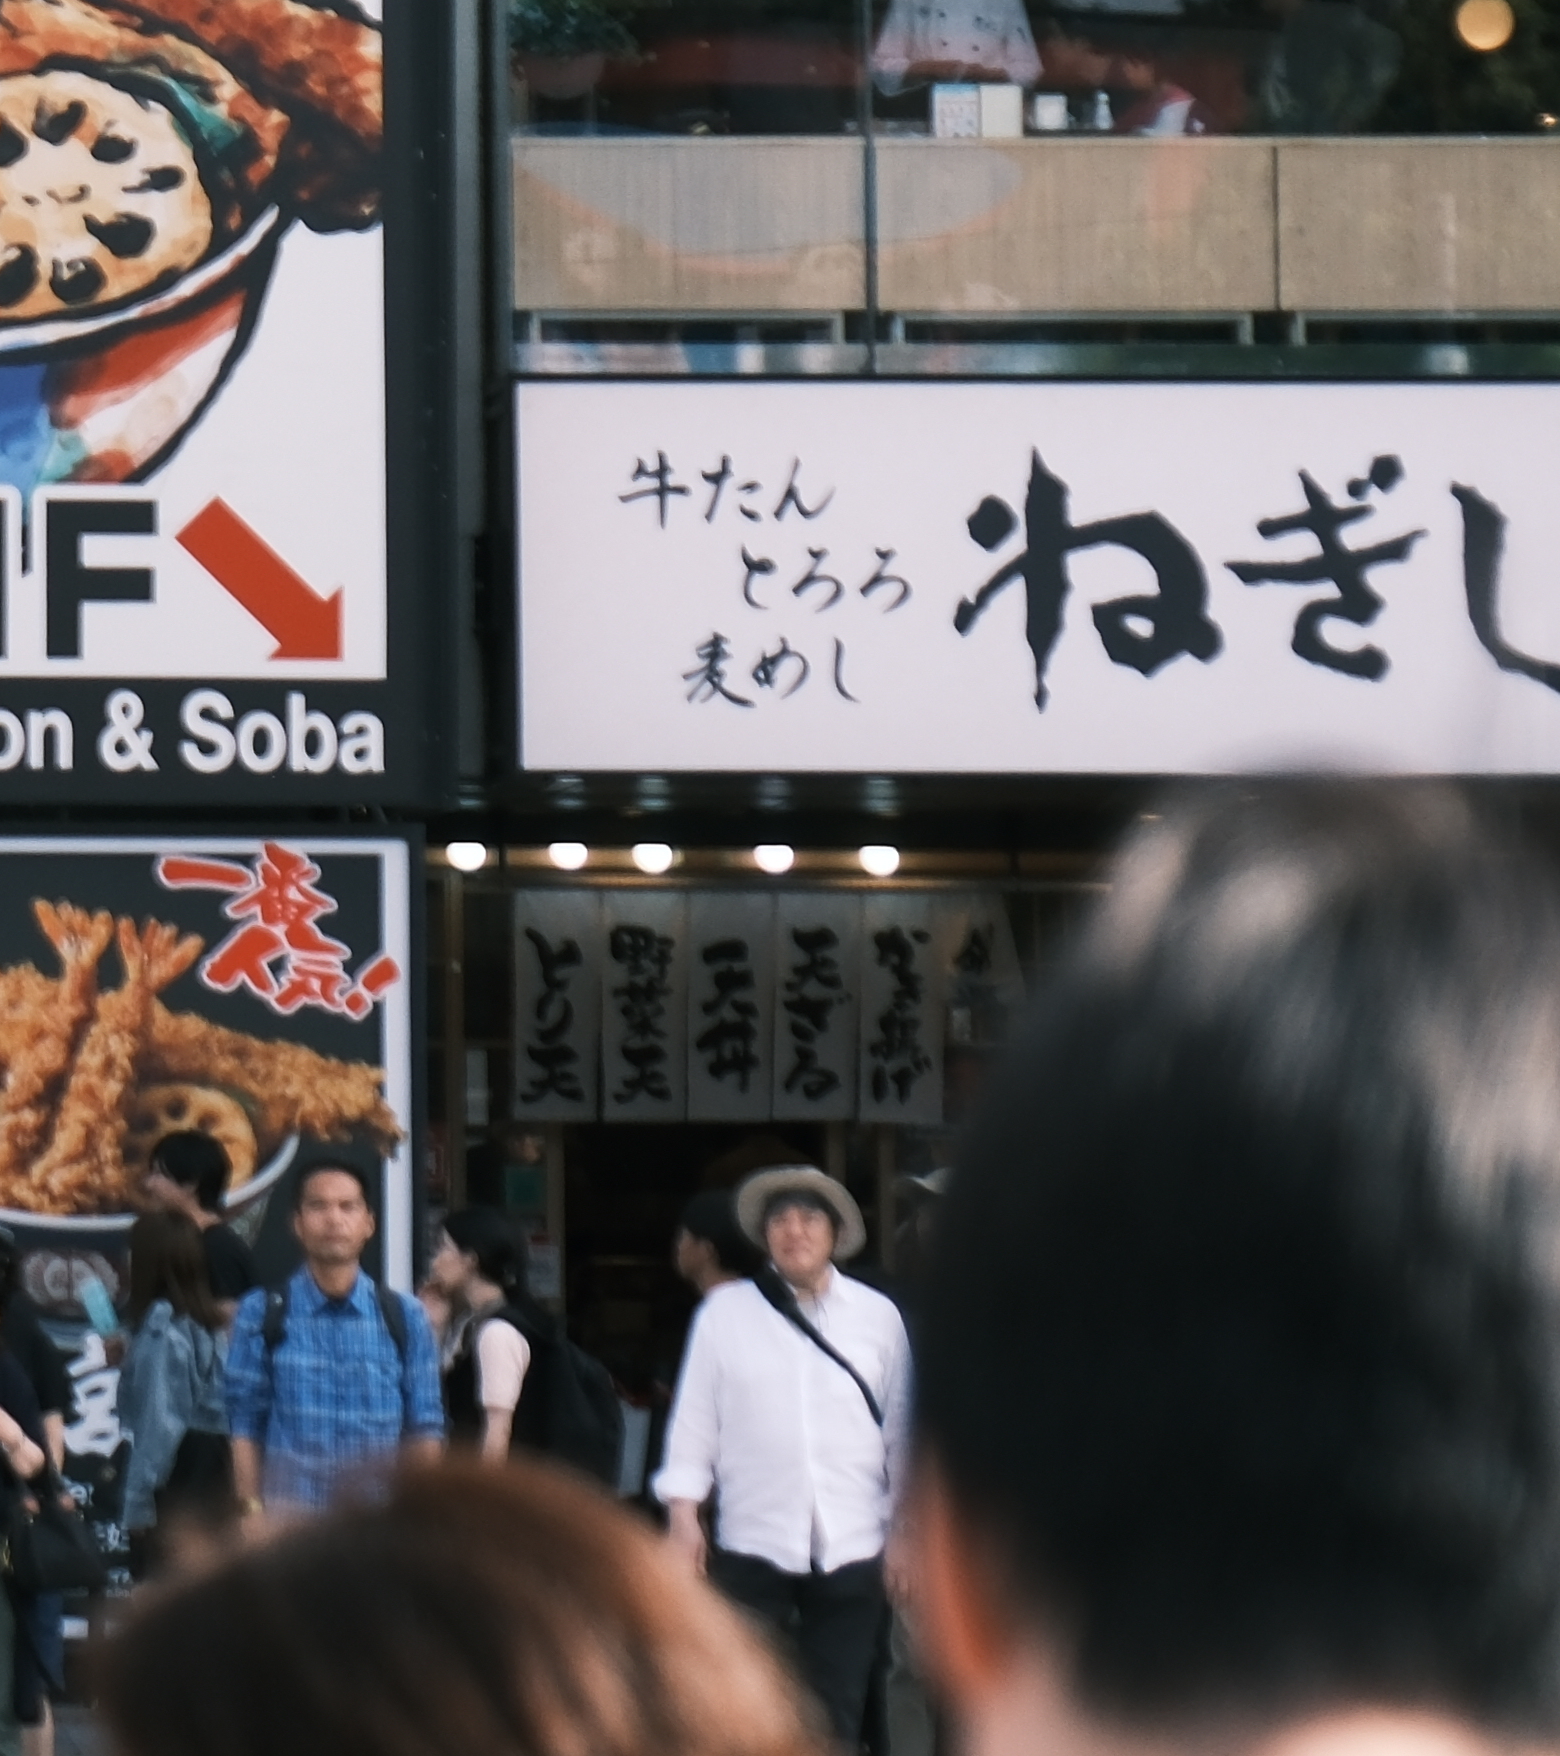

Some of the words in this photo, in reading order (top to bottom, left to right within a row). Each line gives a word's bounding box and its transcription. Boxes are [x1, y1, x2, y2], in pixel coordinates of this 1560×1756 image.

[617, 450, 835, 530] 牛たん
[740, 544, 914, 614] とろろ
[98, 692, 157, 772] &
[179, 692, 386, 775] Soba
